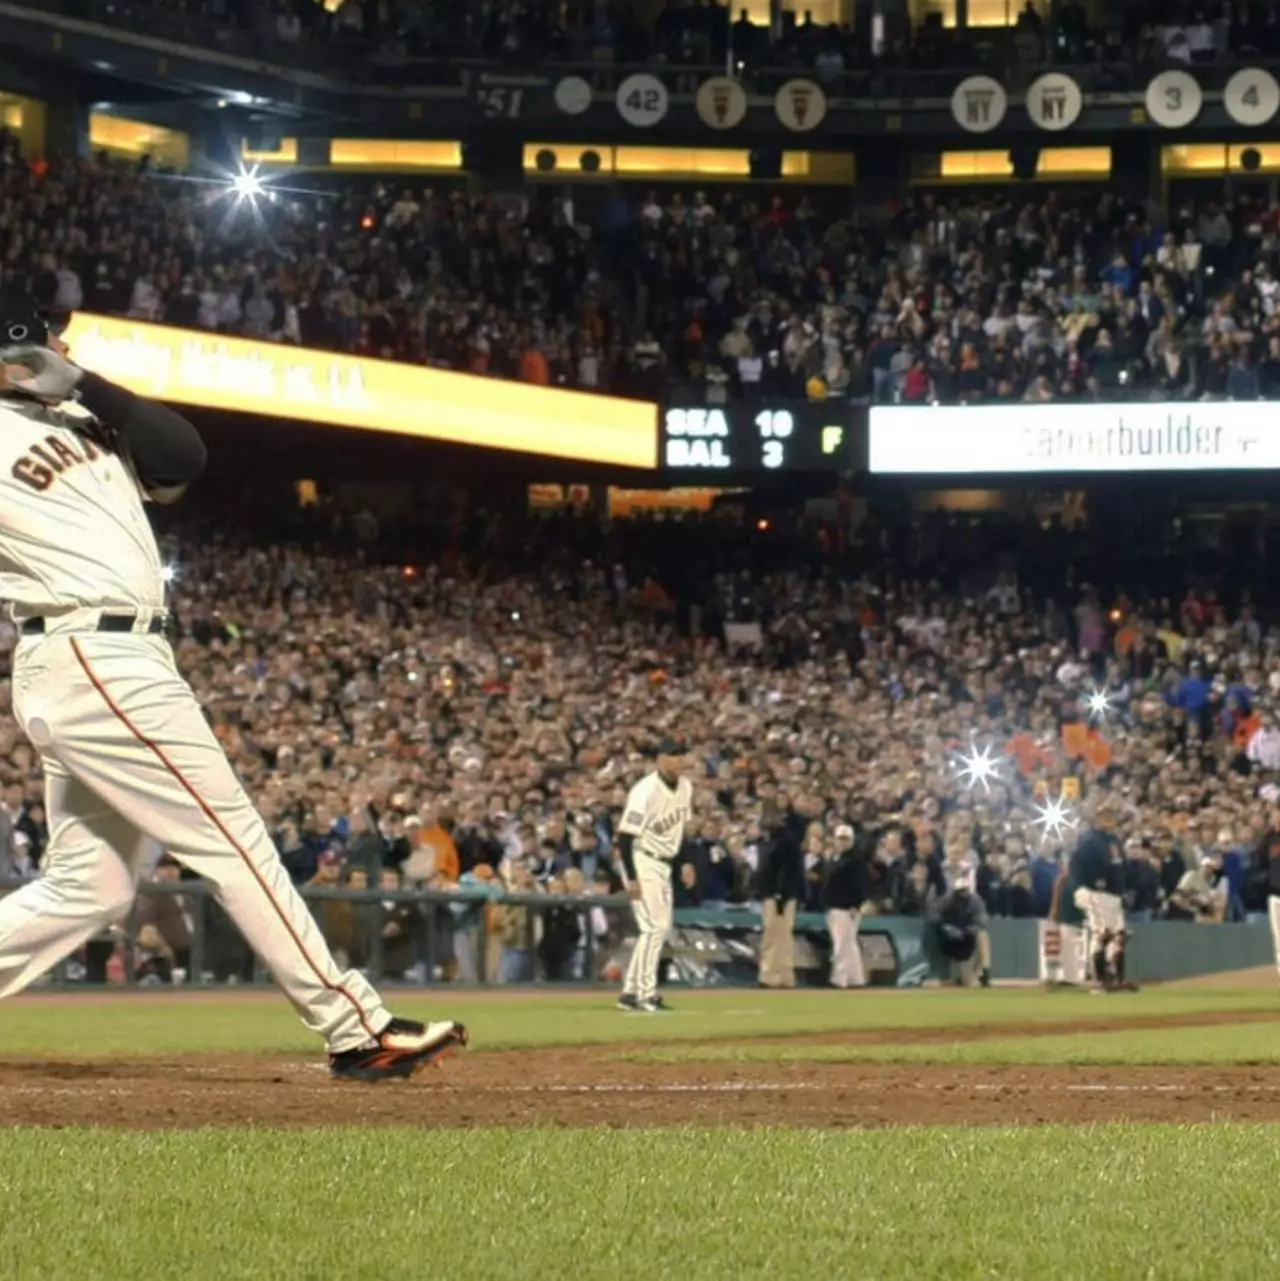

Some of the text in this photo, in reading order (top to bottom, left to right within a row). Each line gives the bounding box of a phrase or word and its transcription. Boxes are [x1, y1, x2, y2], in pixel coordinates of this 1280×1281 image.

[624, 88, 661, 111] 42
[1165, 86, 1183, 110] 3
[1240, 84, 1261, 108] 4
[666, 408, 793, 437] SEA 10
[1022, 414, 1224, 456] arrbuilder
[822, 426, 843, 453] F
[762, 440, 783, 468] 3
